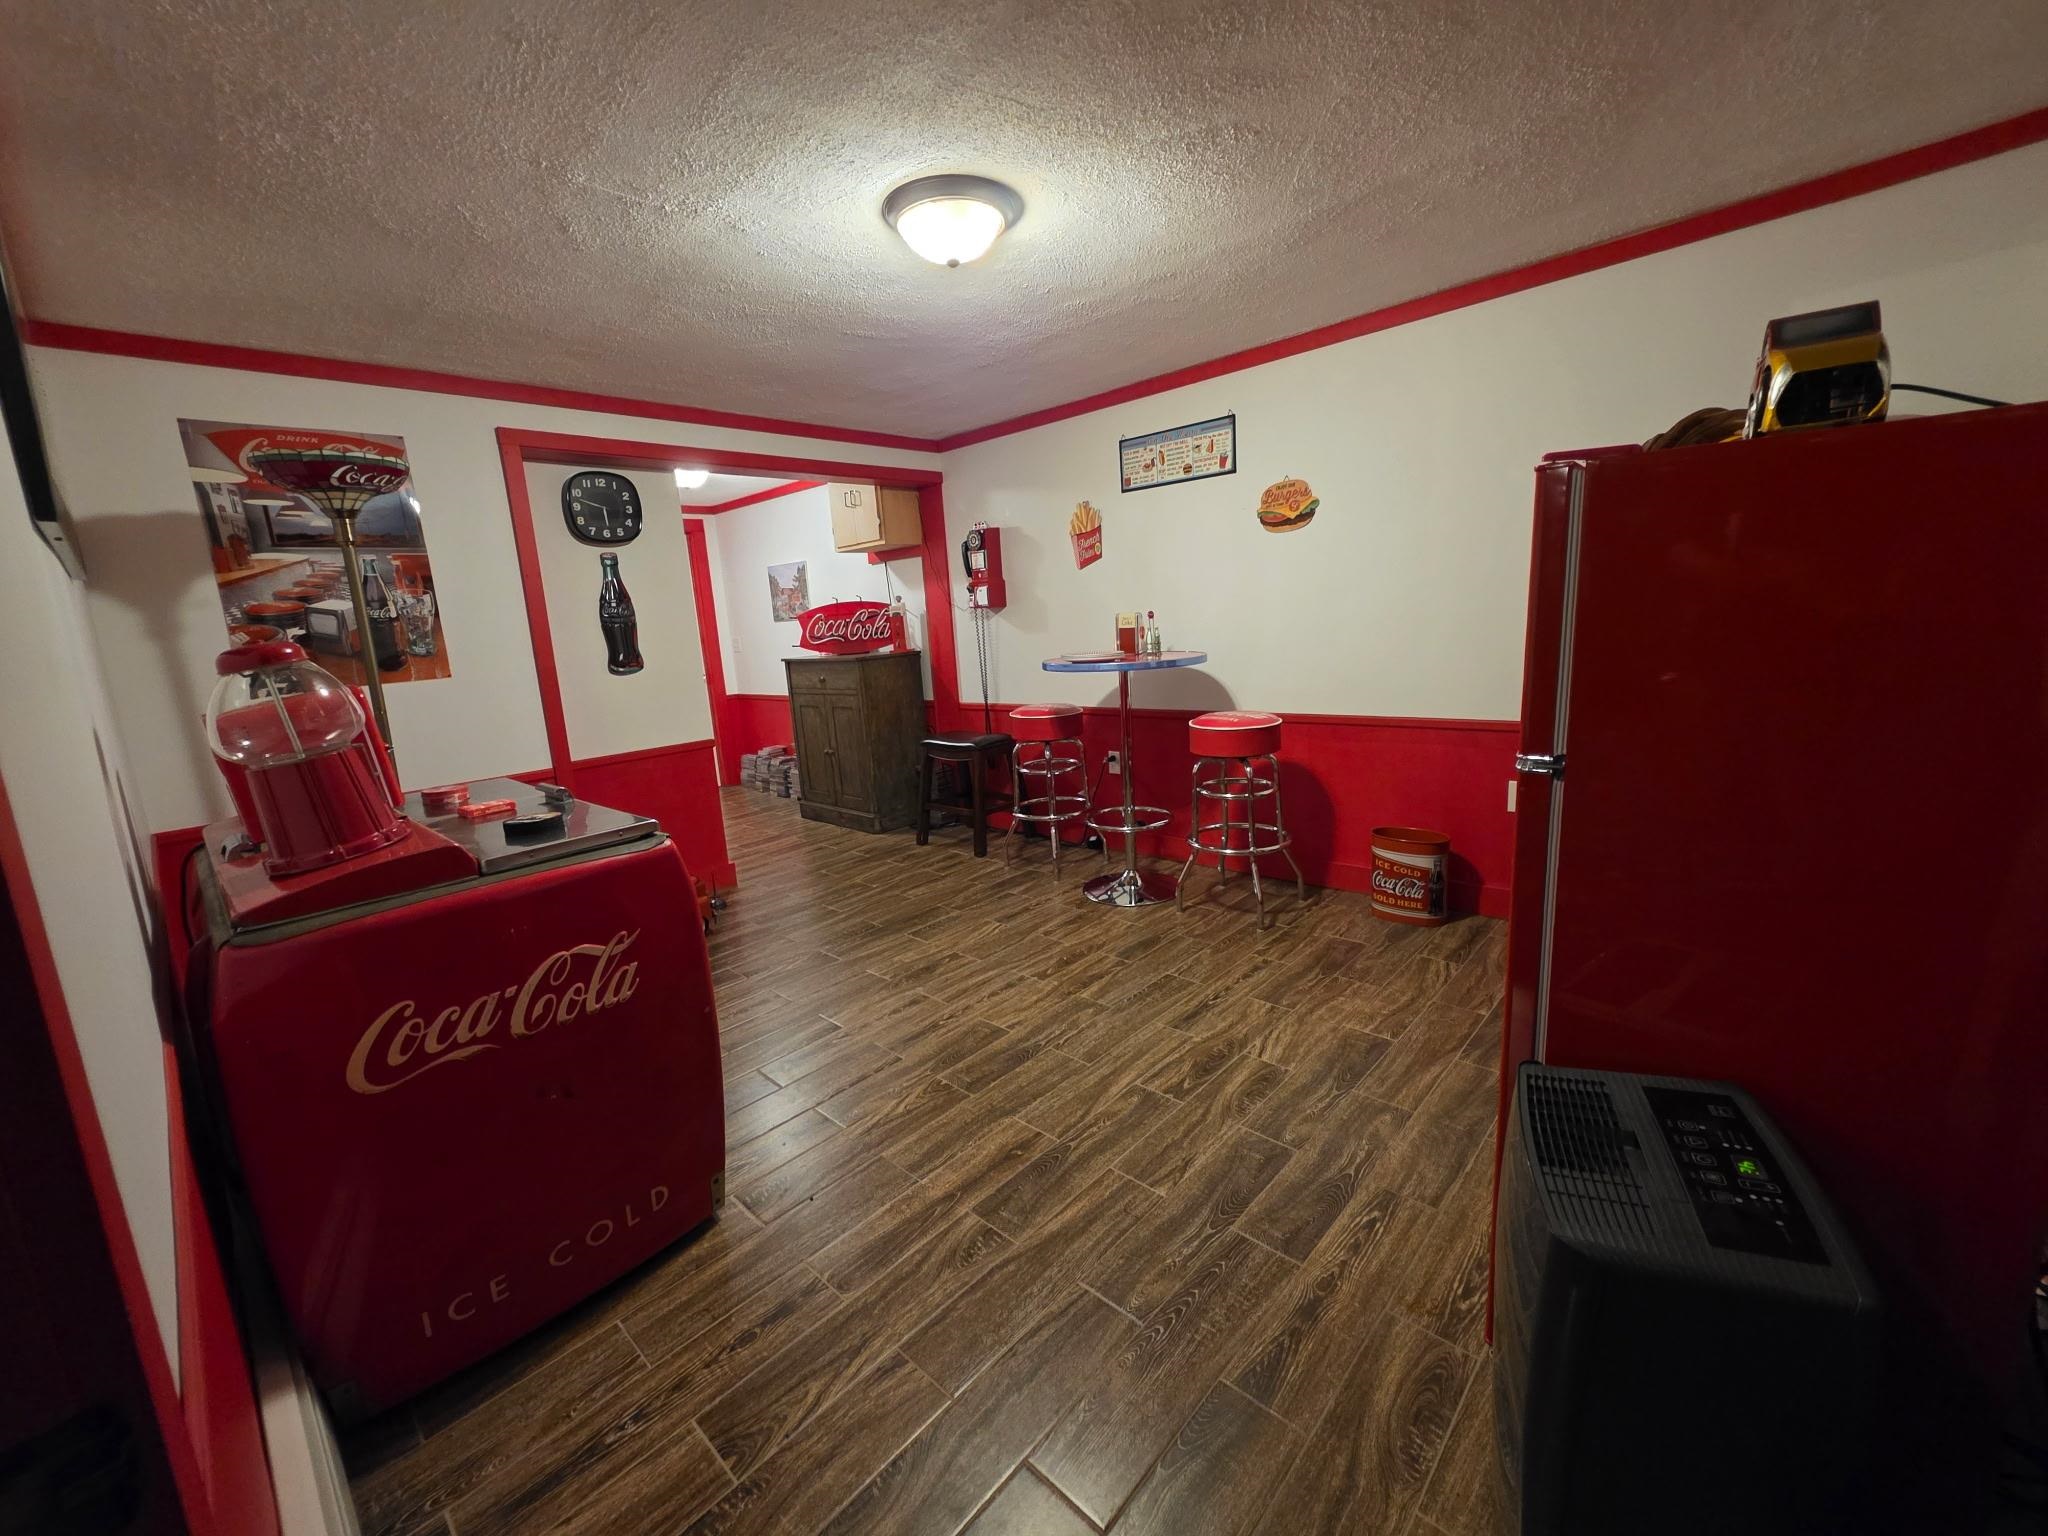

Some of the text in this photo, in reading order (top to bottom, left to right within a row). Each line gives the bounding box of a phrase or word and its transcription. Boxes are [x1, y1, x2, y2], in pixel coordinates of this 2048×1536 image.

[276, 434, 319, 444] DRINK
[582, 479, 591, 488] 11
[595, 478, 606, 487] 12
[572, 488, 582, 498] 10
[622, 492, 630, 500] 2
[1263, 486, 1312, 504] Burgers
[572, 502, 581, 511] 9
[625, 506, 633, 514] 3
[577, 516, 585, 525] 8
[625, 518, 633, 527] 4
[588, 527, 597, 536] 7
[603, 529, 611, 538] 6
[616, 528, 624, 536] 5
[1078, 533, 1100, 551] French
[807, 608, 891, 644] Coca-Cola
[1376, 858, 1421, 877] ICE COLD
[1372, 869, 1426, 899] Coca-Cola
[1373, 893, 1424, 909] SOLD HERE
[345, 927, 641, 1095] Coca-Cola
[421, 1185, 670, 1338] ICE COLD
